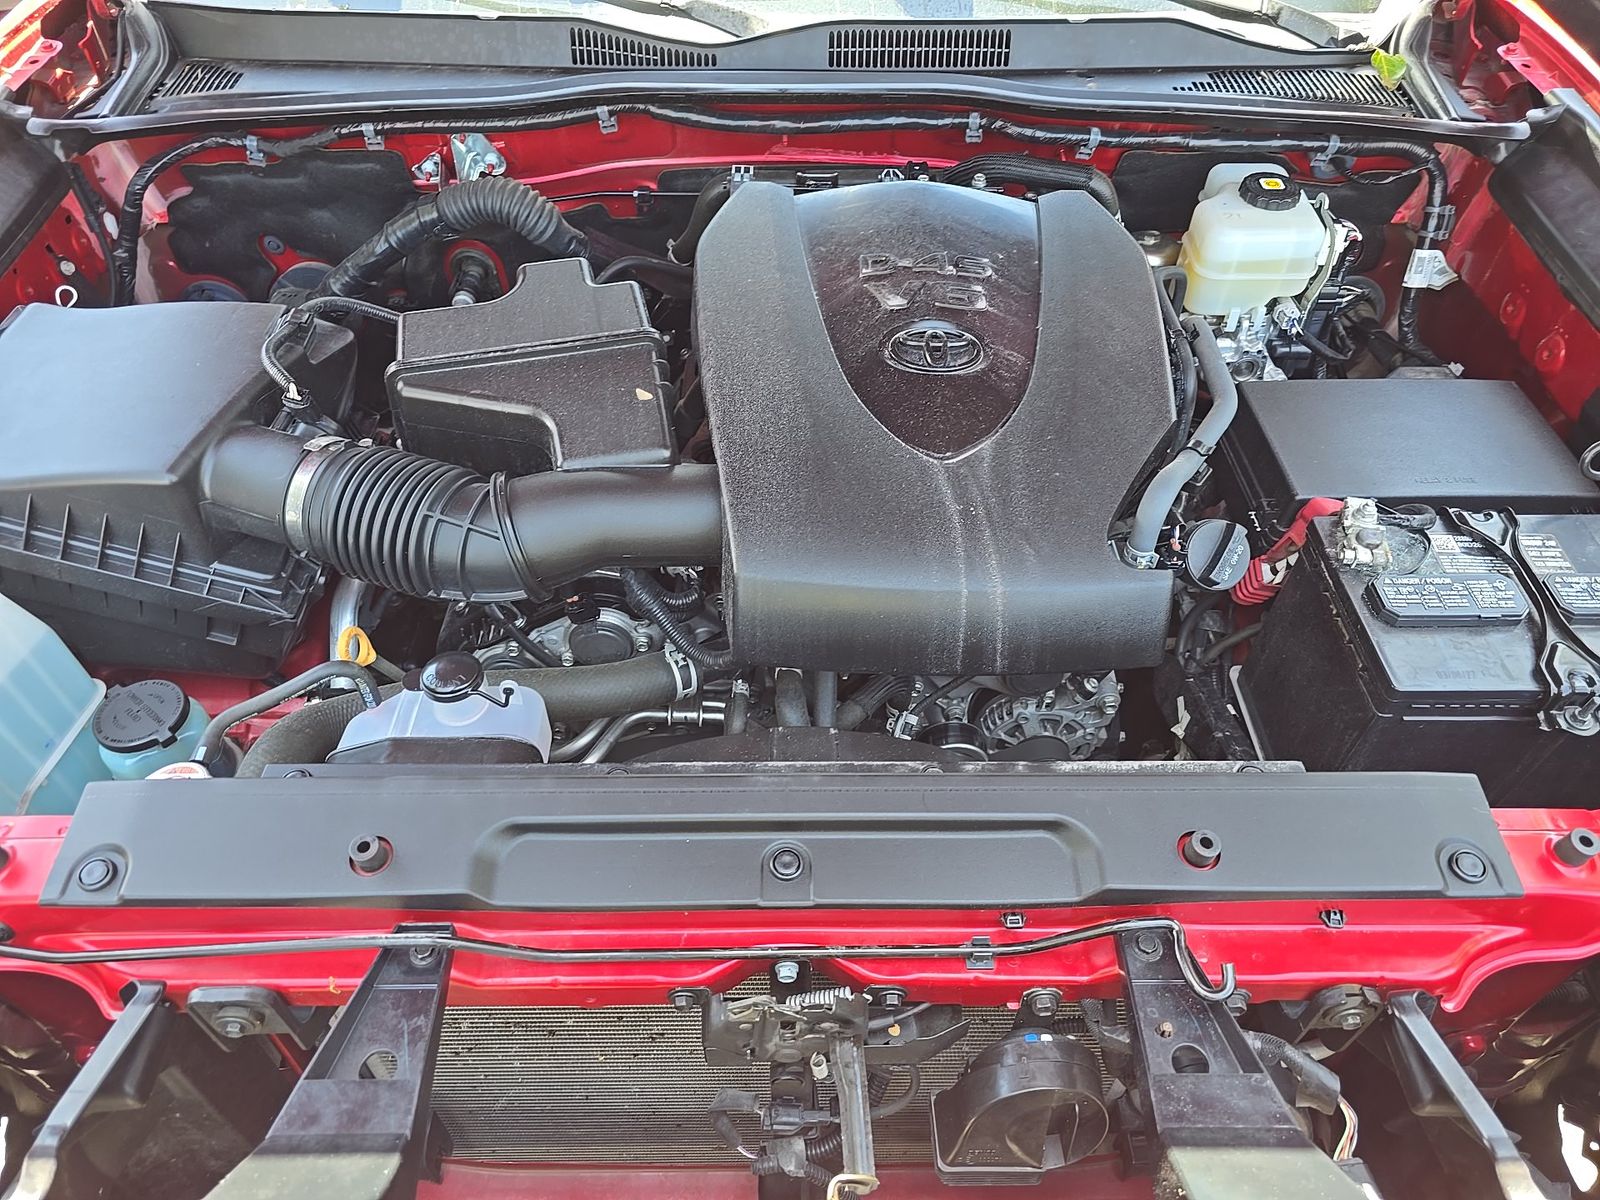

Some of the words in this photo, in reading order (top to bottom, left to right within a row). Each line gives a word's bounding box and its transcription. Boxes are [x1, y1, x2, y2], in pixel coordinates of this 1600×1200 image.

[863, 279, 989, 312] V6
[1223, 566, 1232, 580] SAE
[1231, 544, 1243, 564] 0W-20
[425, 673, 466, 688] COOLANT
